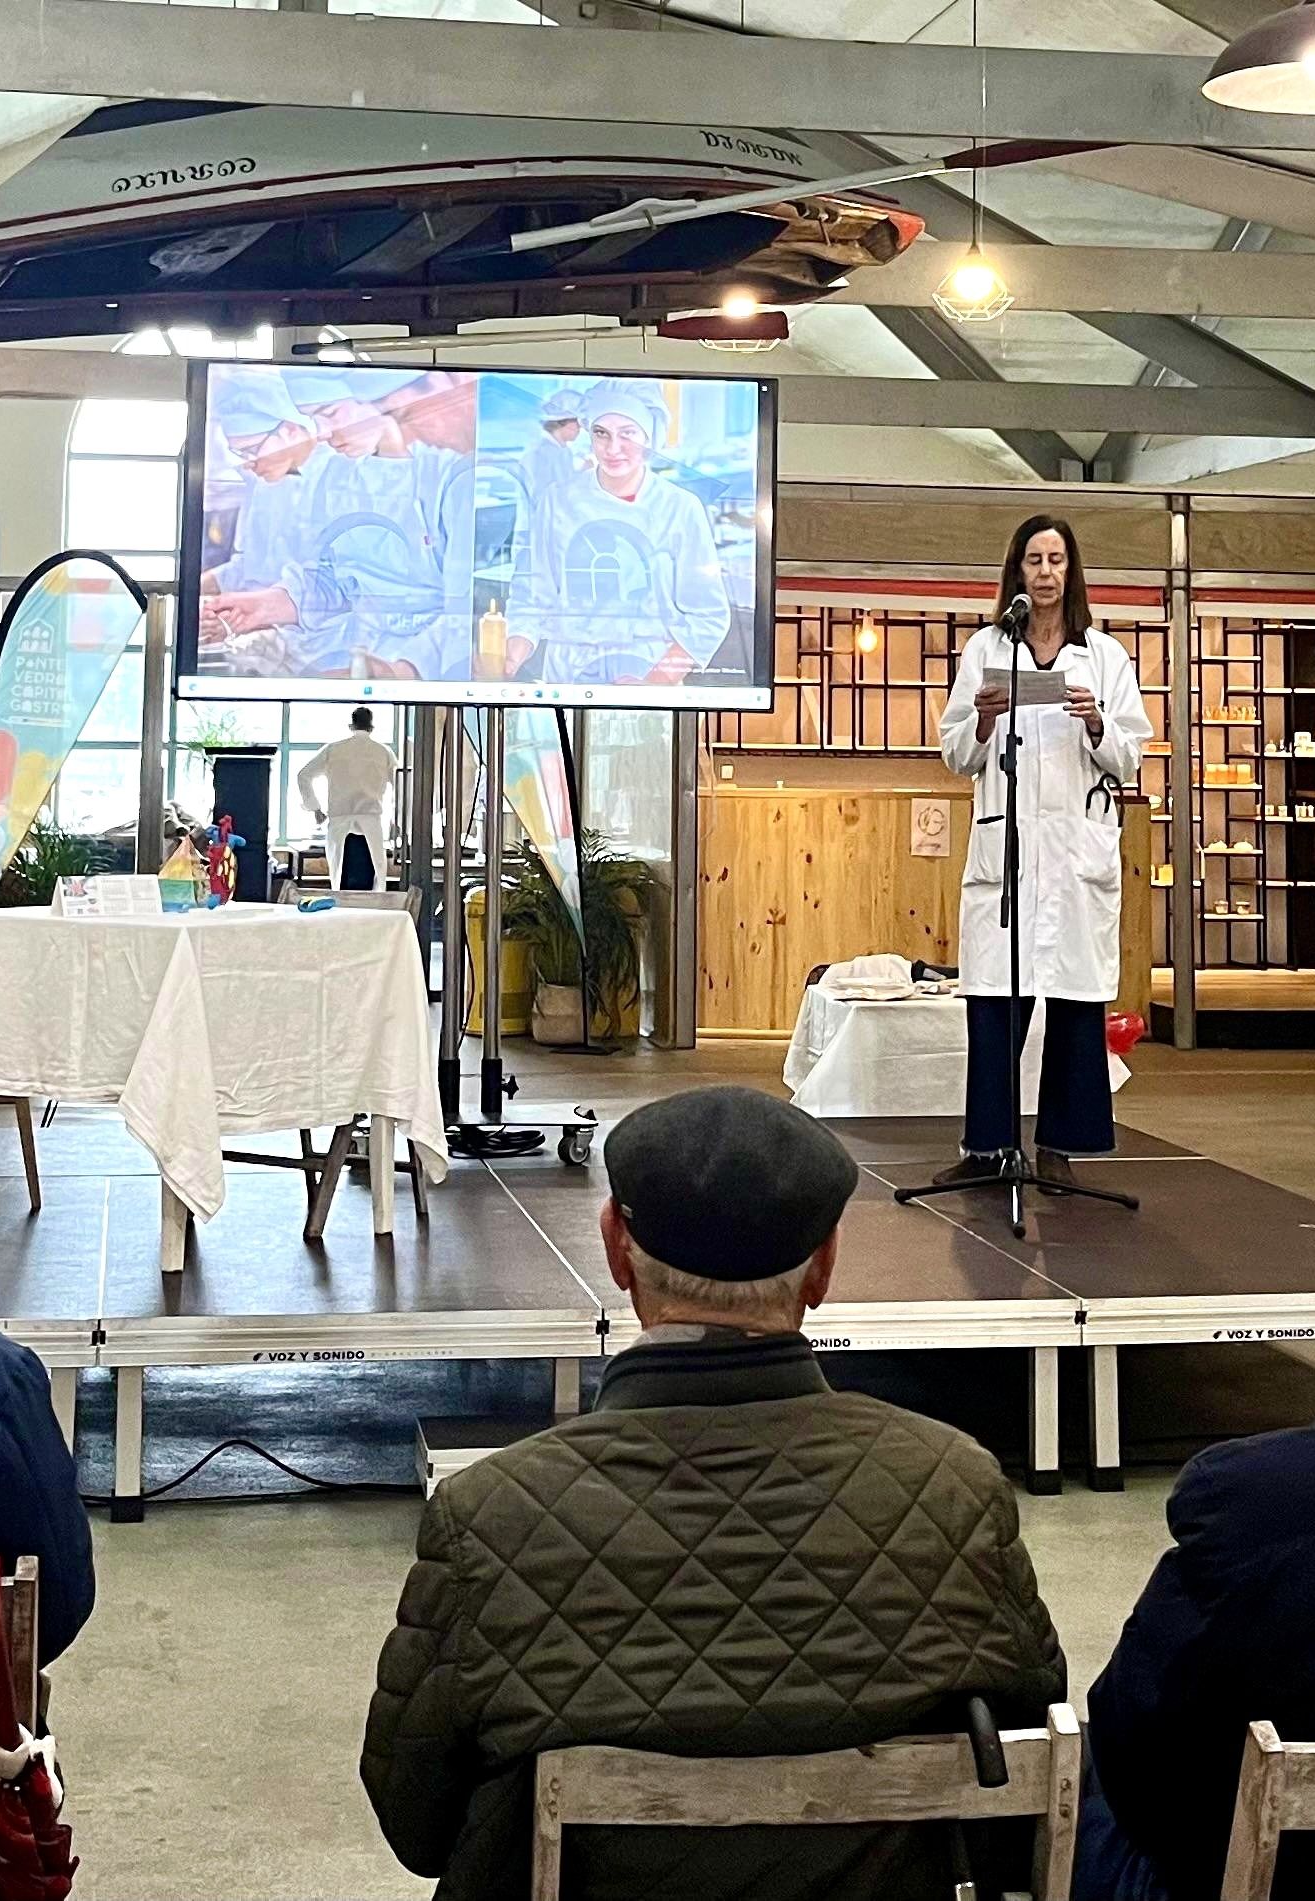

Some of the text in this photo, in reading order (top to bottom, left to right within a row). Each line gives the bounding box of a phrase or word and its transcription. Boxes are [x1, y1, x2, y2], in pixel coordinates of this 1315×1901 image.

[111, 157, 256, 193] CORUXO
[1227, 1329, 1253, 1339] VOZ
[1256, 1329, 1264, 1338] Y
[1267, 1328, 1315, 1338] SONIDO
[811, 1338, 851, 1348] ONIDO
[268, 1352, 296, 1362] VOZ
[299, 1352, 309, 1361] Y
[313, 1350, 365, 1361] SONIDO
